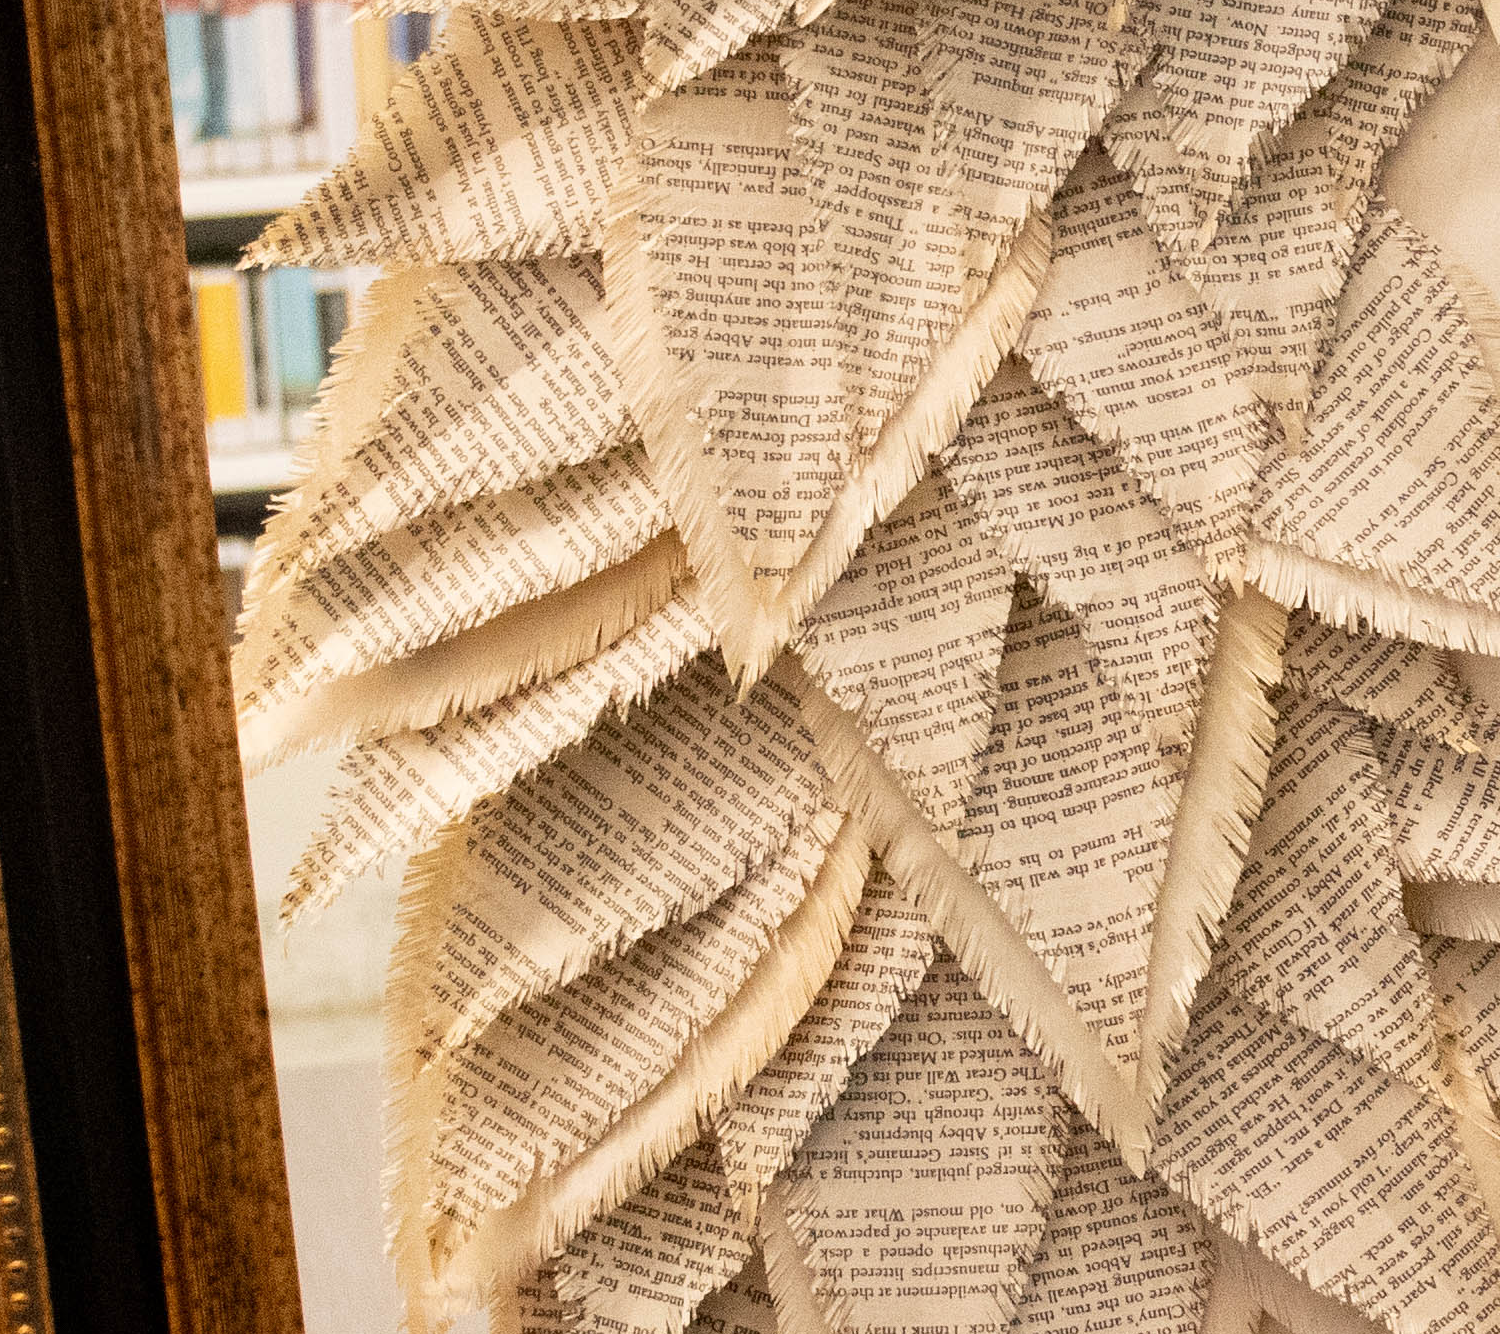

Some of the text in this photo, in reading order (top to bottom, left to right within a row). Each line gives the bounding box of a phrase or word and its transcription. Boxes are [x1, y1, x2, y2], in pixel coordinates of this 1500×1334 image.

[667, 178, 730, 196] Matthias
[718, 275, 757, 290] lunch
[763, 279, 785, 292] the
[791, 281, 814, 292] out
[747, 354, 804, 368] weather
[1178, 353, 1231, 379] distract
[1139, 368, 1173, 387] your
[1013, 499, 1135, 535] sword of Martin
[872, 1049, 1014, 1065] winked Matthias
[873, 1073, 890, 1085] its
[896, 1072, 922, 1085] and
[928, 1070, 959, 1084] Wall
[966, 1068, 1007, 1081] Great
[843, 1105, 1044, 1123] swiftly through the dusty
[933, 1127, 987, 1141] Abbey
[806, 1151, 848, 1165] literal
[949, 1146, 989, 1160] Sister
[833, 1167, 902, 1184] clutching
[836, 1209, 858, 1219] are
[865, 1209, 904, 1222] What
[911, 1206, 963, 1221] mouse!
[970, 1206, 993, 1218] old
[894, 1225, 1008, 1243] an avalanche of
[820, 1248, 853, 1262] desk
[880, 1244, 933, 1261] opened
[820, 1260, 999, 1283] manuscripts littered the
[851, 1284, 997, 1300] bewilderment the
